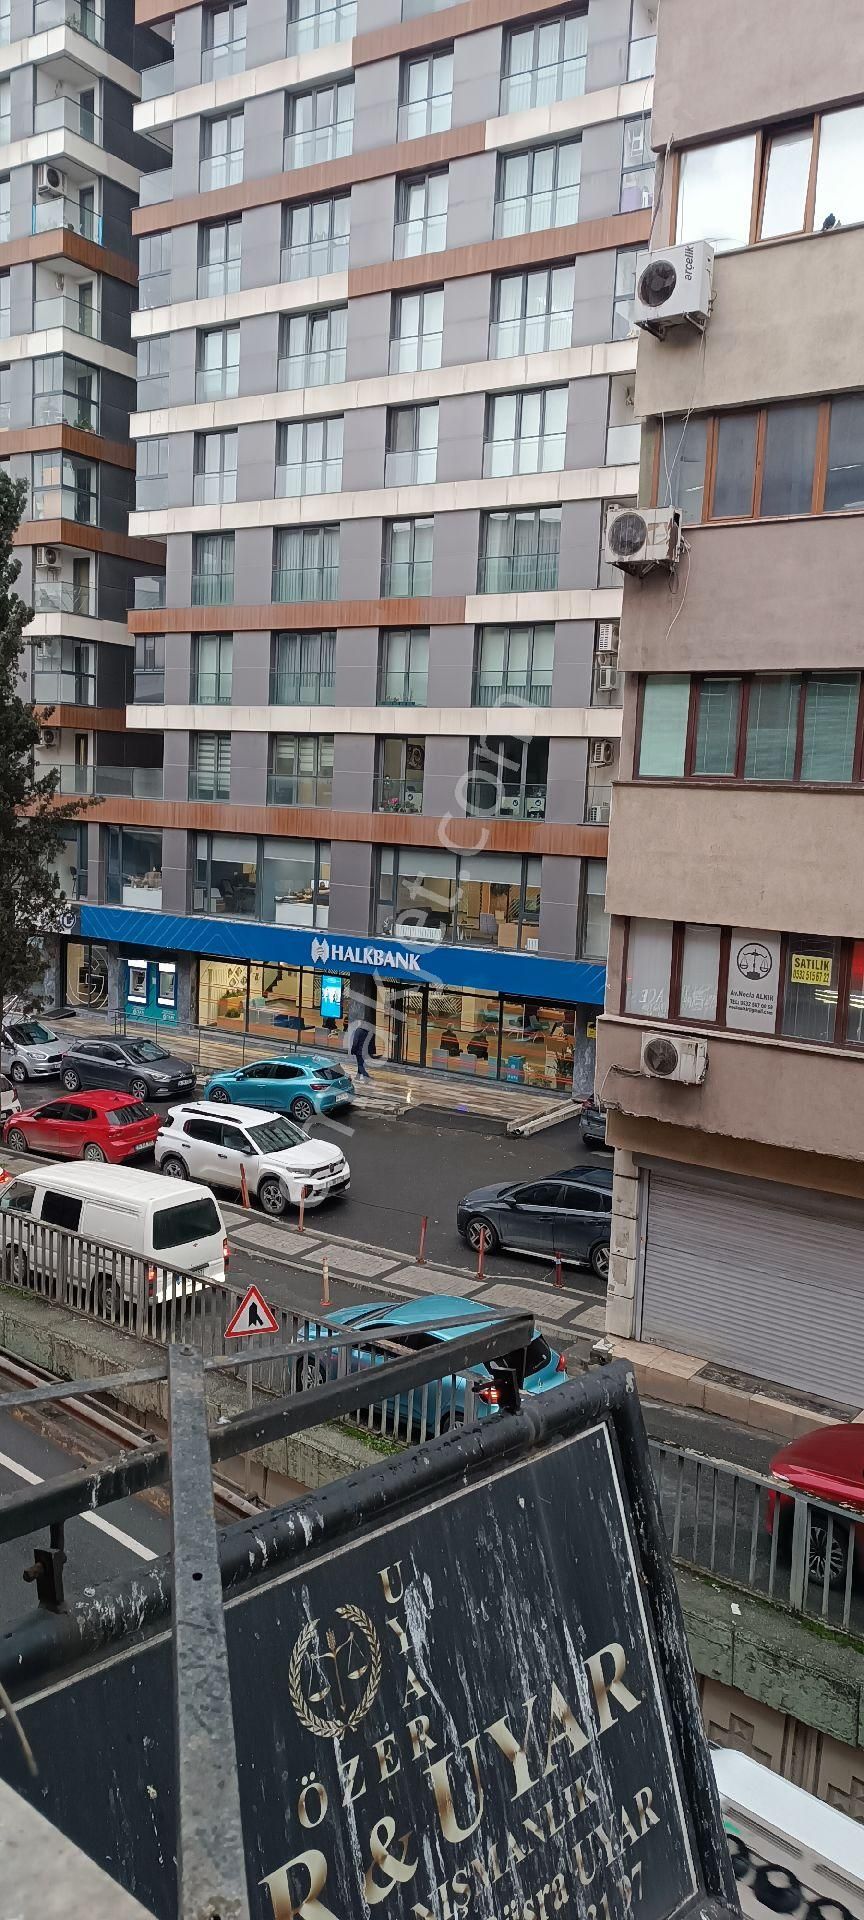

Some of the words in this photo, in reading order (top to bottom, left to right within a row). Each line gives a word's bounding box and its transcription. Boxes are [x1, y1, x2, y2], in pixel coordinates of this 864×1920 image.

[684, 246, 695, 281] arçelik
[331, 944, 421, 971] HALKBANK
[794, 957, 830, 971] SATILIK
[297, 1714, 437, 1829] ÖZER
[364, 1817, 419, 1905] &
[422, 1642, 641, 1844] UYAR
[571, 1786, 661, 1886] UYAR
